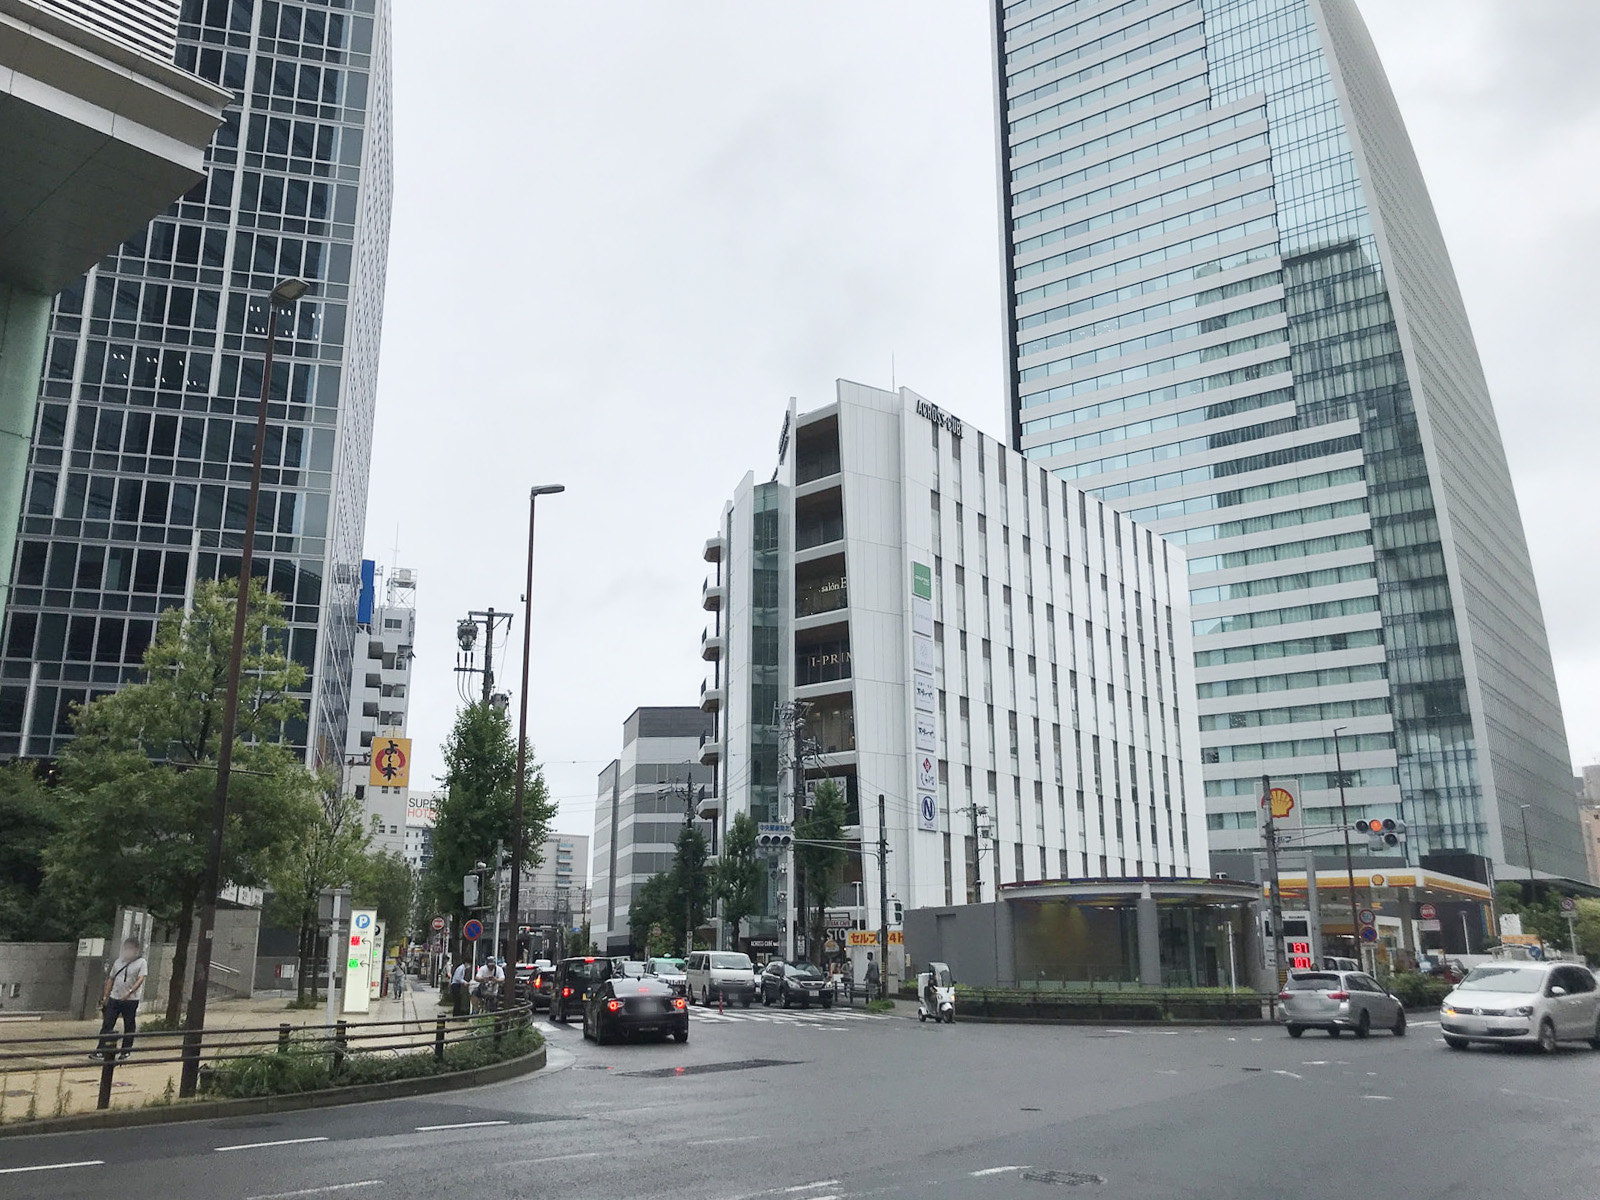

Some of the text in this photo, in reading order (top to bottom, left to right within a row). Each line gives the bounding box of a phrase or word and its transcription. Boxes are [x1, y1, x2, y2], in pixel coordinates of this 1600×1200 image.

[408, 797, 439, 808] SUPE
[407, 808, 438, 820] HOTE
[851, 933, 877, 944] セルフ
